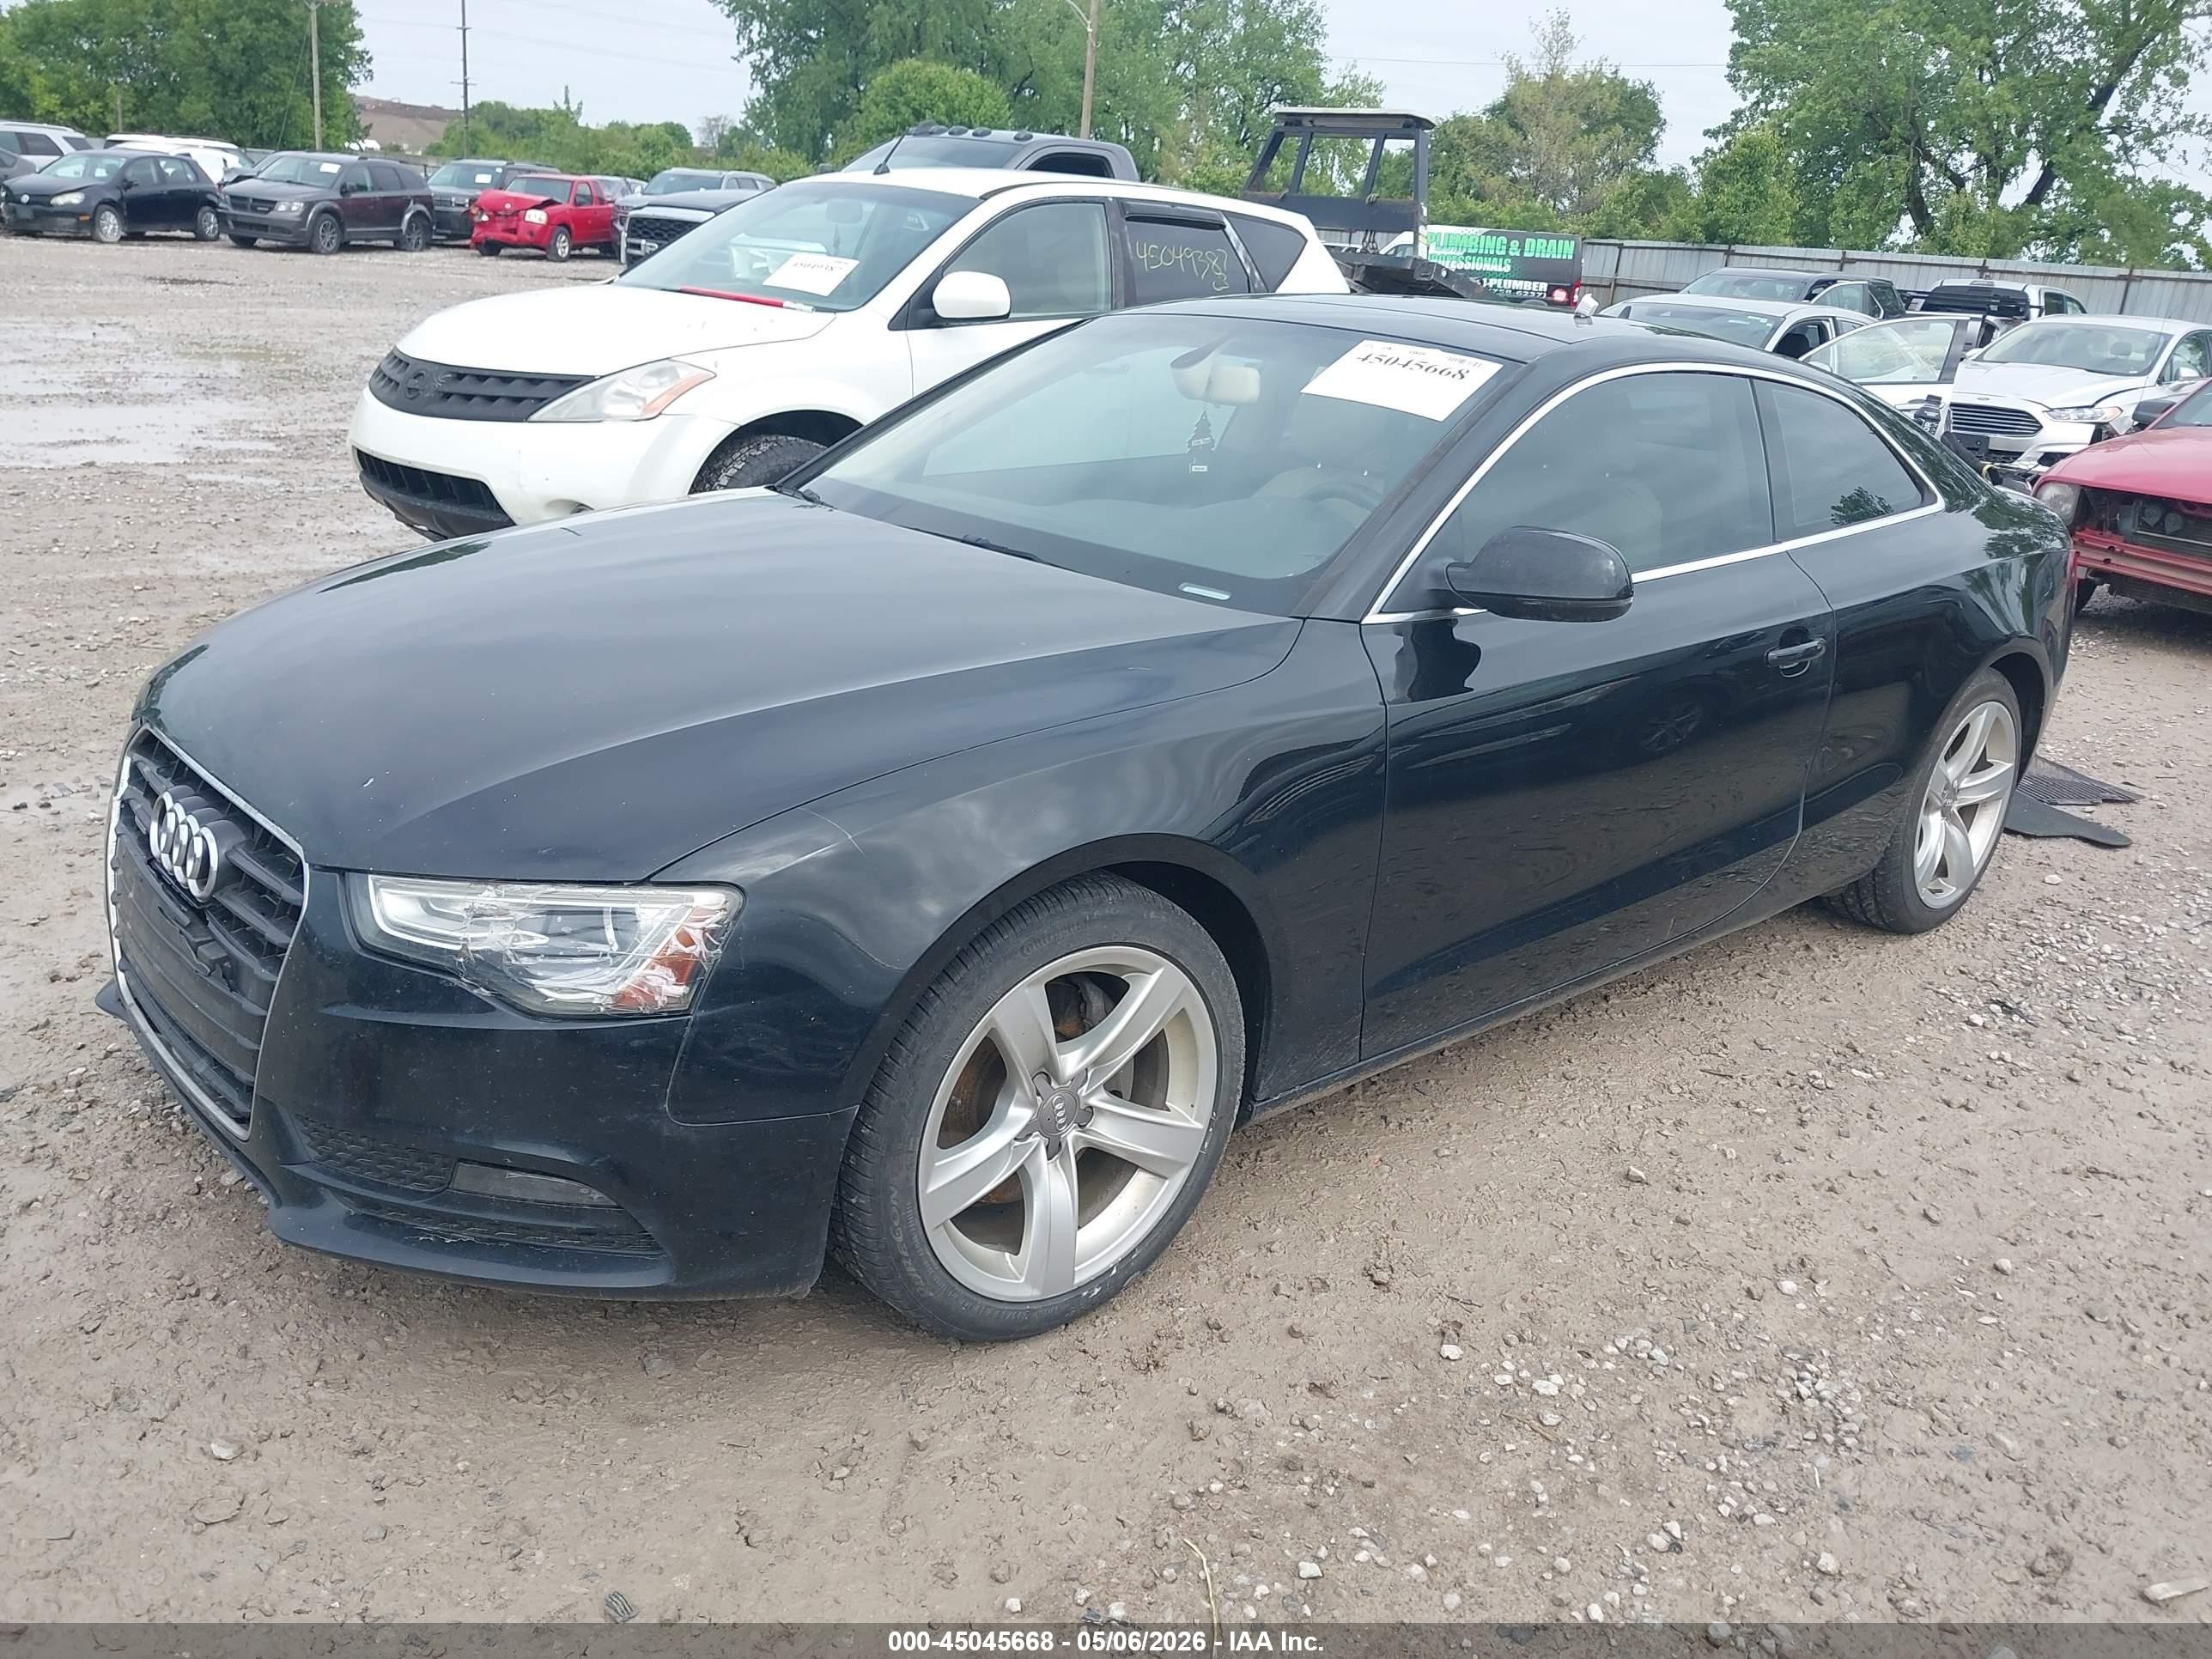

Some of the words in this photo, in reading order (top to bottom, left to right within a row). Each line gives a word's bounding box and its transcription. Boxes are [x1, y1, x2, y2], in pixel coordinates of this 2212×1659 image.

[1426, 232, 1507, 256] PLUMBING
[1509, 240, 1521, 257] &
[1522, 238, 1575, 259] DRAIN
[1357, 352, 1470, 380] 45045668
